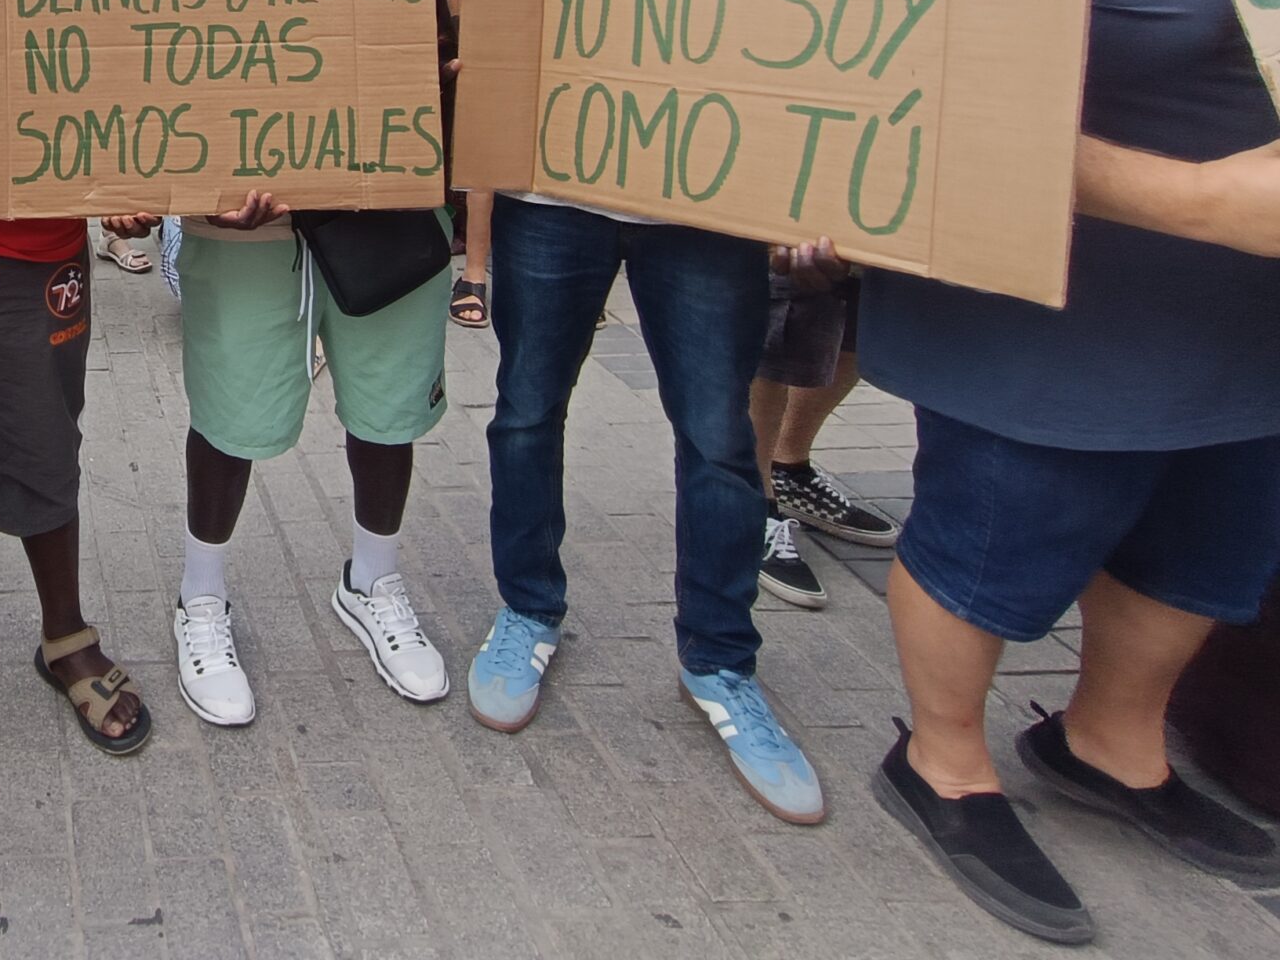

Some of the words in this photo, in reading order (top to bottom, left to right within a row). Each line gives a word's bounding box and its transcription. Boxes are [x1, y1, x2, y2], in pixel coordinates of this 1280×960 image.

[24, 24, 91, 94] NO
[131, 16, 323, 86] TODAS
[12, 103, 209, 185] SOMOS
[231, 105, 444, 178] IGUALES
[539, 82, 741, 202] COMO
[786, 88, 922, 236] TÚ
[51, 279, 81, 311] 72
